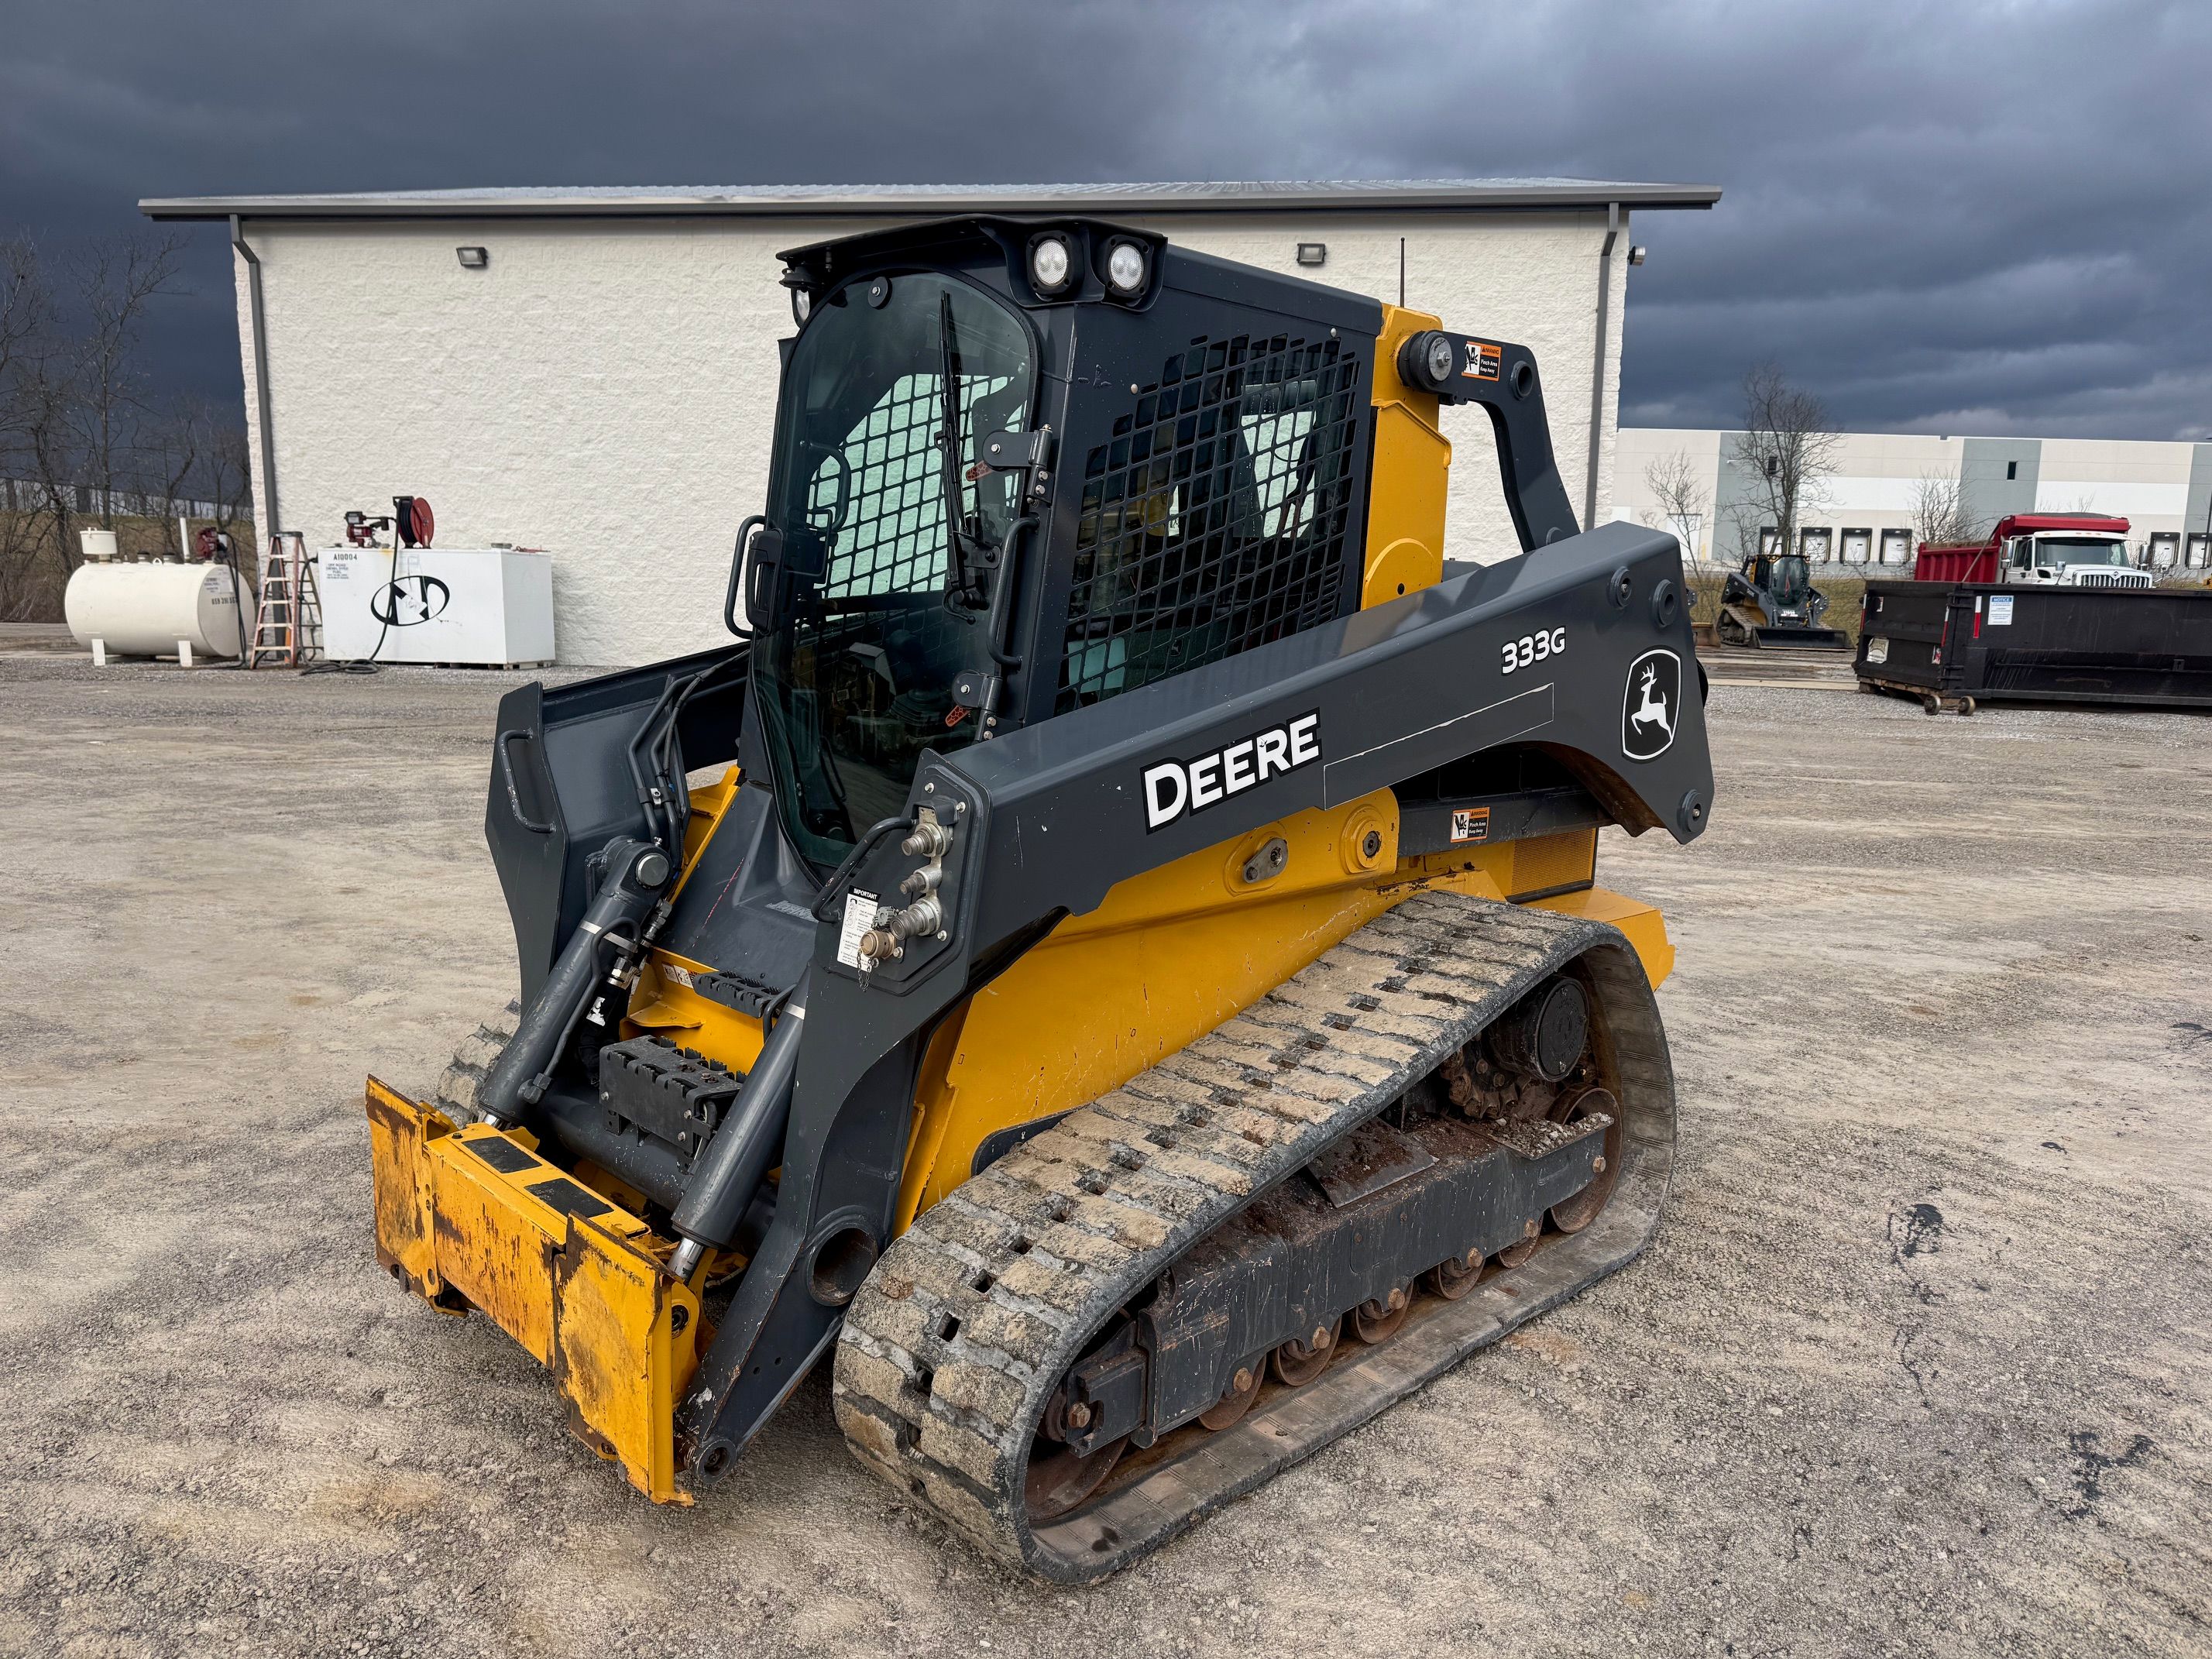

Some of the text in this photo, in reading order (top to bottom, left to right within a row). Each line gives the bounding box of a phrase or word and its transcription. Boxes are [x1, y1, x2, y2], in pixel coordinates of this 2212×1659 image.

[1502, 627, 1565, 674] 333G
[1144, 713, 1320, 829] DEERE
[853, 888, 878, 899] IMPORTANT
